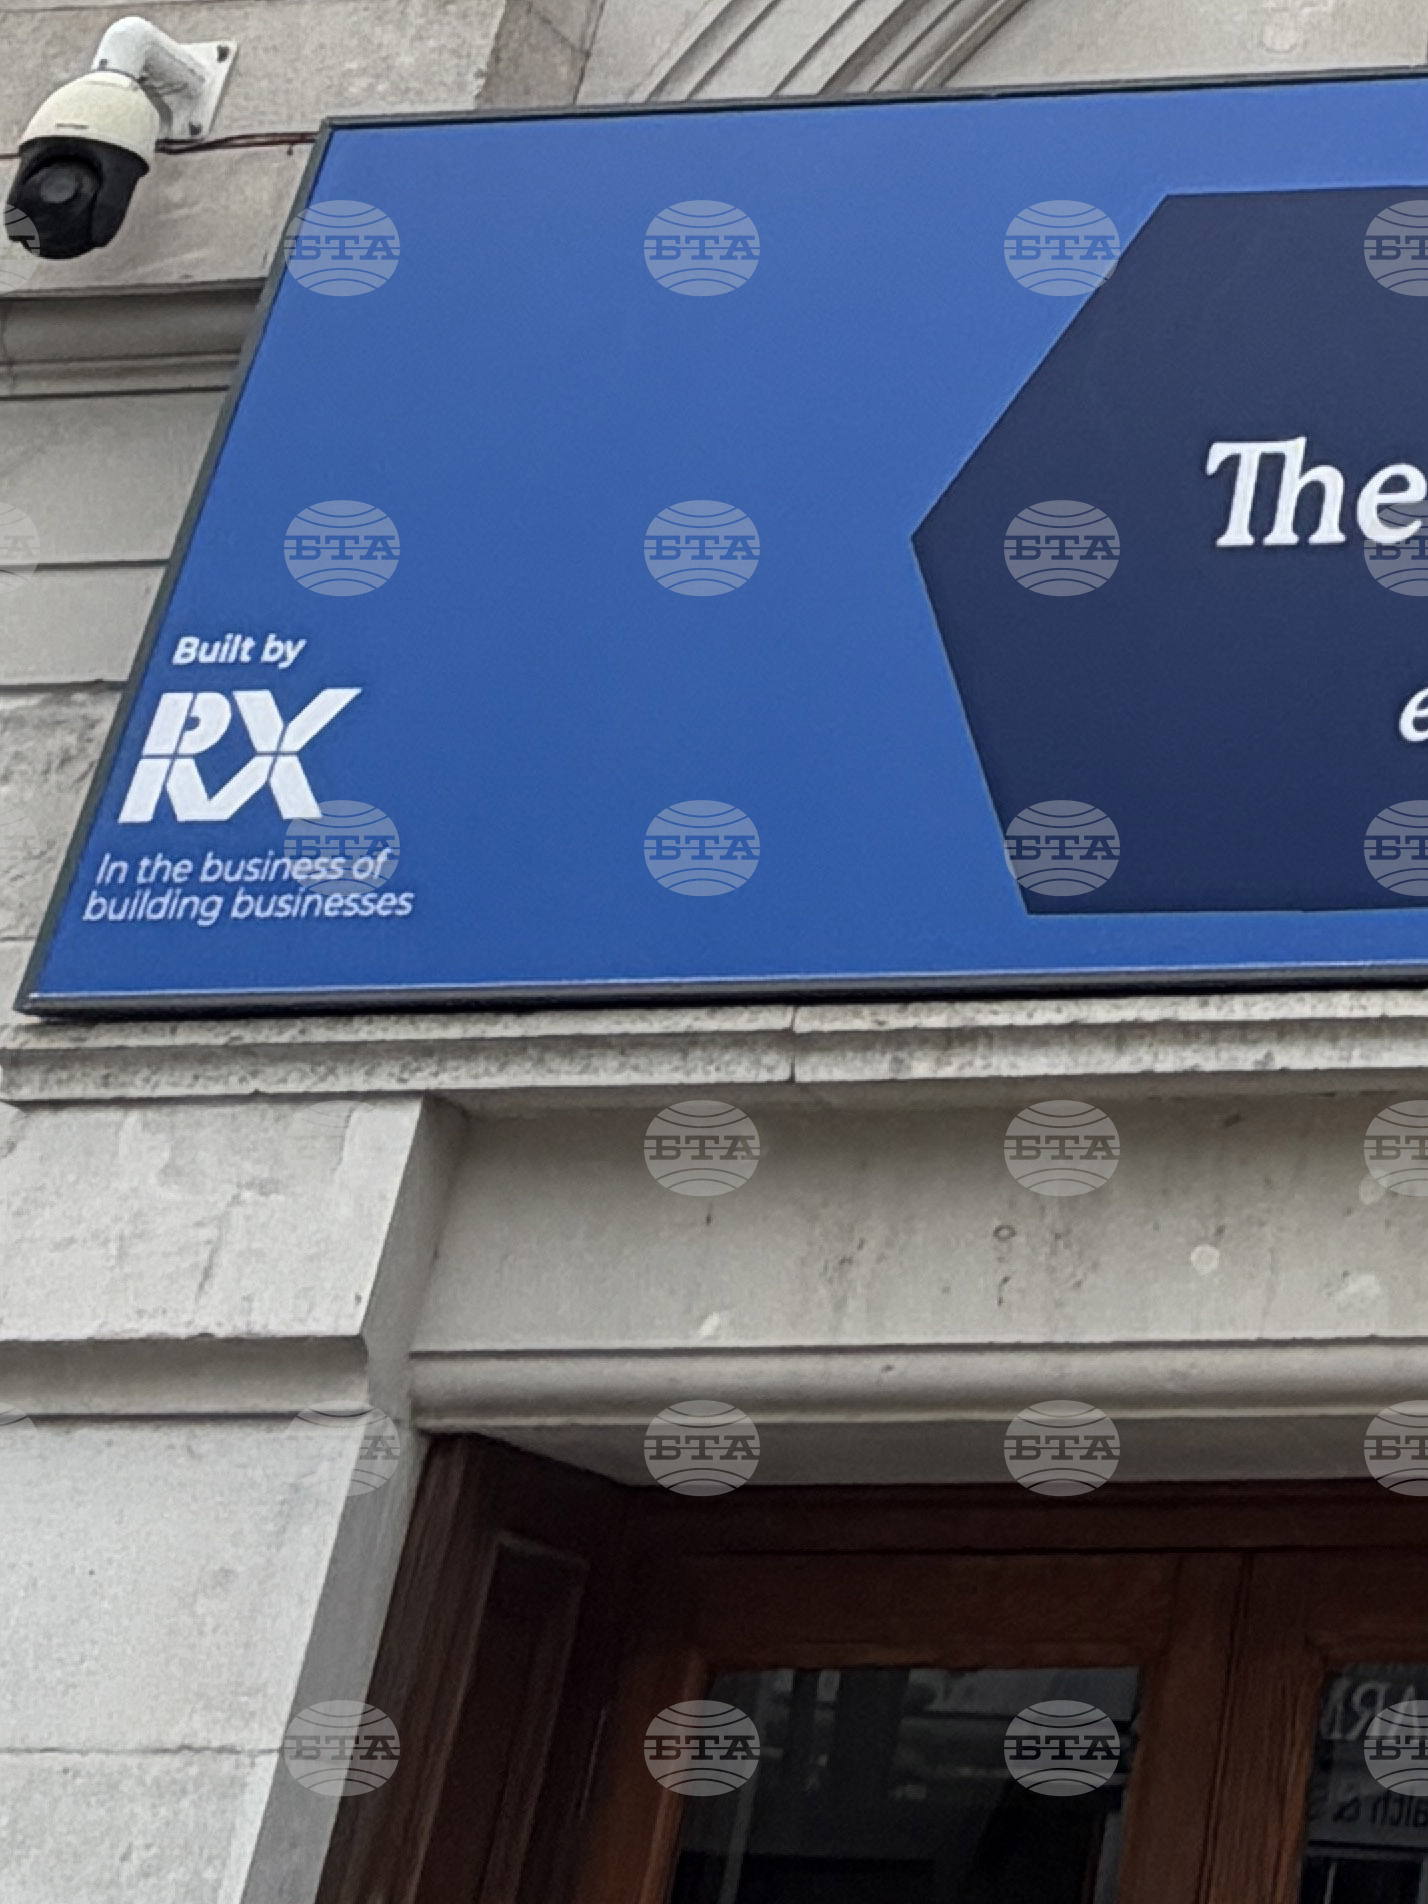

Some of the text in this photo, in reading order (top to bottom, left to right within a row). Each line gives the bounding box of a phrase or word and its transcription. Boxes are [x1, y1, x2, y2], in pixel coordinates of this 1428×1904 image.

[1205, 435, 1428, 547] The
[171, 632, 308, 669] Built by
[118, 687, 363, 824] RX
[95, 845, 394, 885] In the business of
[82, 887, 417, 927] building businesses
